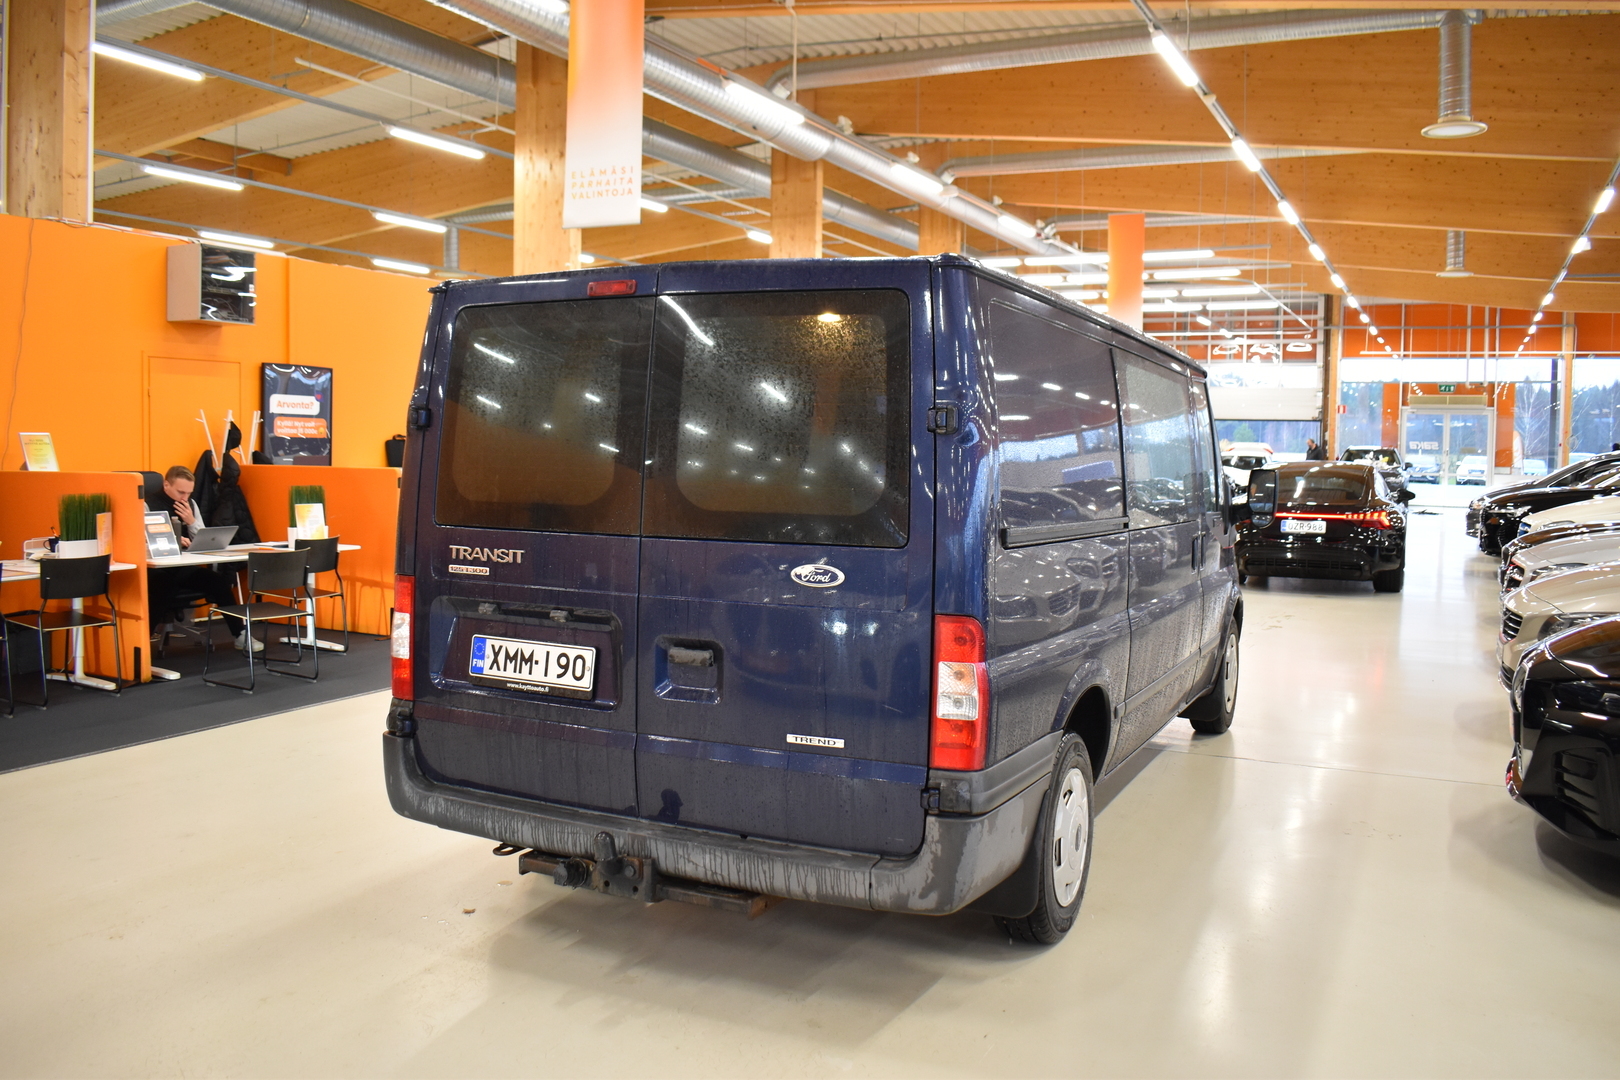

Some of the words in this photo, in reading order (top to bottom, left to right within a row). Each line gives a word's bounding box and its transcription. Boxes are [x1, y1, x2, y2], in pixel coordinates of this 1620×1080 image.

[571, 166, 634, 180] ELÄMÄSI
[571, 177, 633, 190] PARHAITA
[571, 188, 633, 200] VALINTOJA
[276, 400, 314, 410] Arvonta?
[449, 545, 525, 563] TRANSIT
[801, 569, 832, 582] Ford
[472, 658, 484, 668] FIN
[488, 643, 587, 682] XMM-190
[506, 682, 549, 692] www.kayttoauto.fi
[793, 736, 836, 746] TREND
